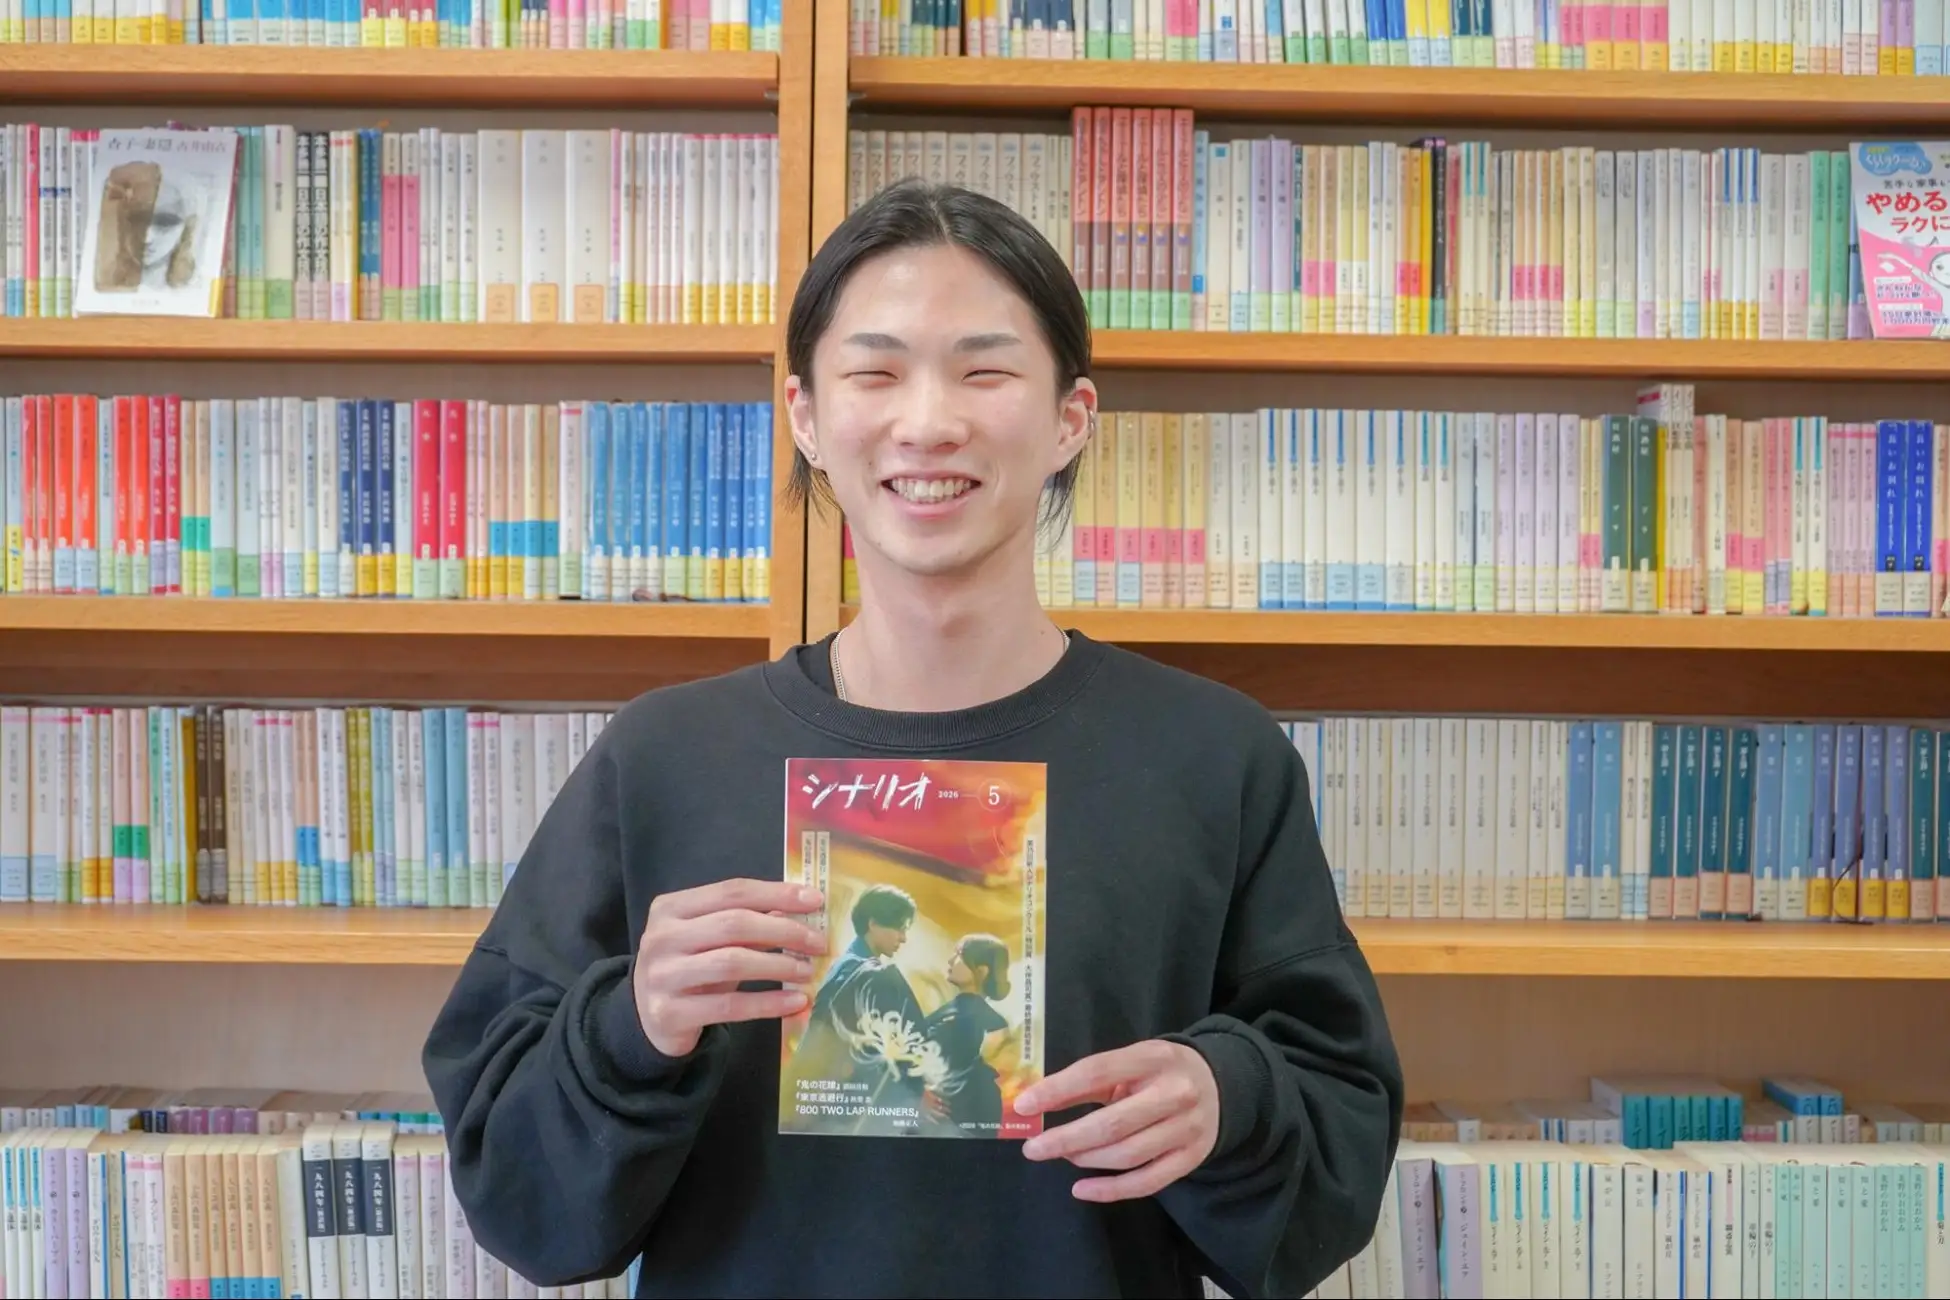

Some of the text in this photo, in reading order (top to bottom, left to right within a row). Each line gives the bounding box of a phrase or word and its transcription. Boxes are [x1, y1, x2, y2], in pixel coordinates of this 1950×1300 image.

[1866, 191, 1948, 216] やめる
[802, 773, 1000, 811] シナリオ 2026 5
[820, 1106, 844, 1115] TWO
[846, 1106, 866, 1116] LAP
